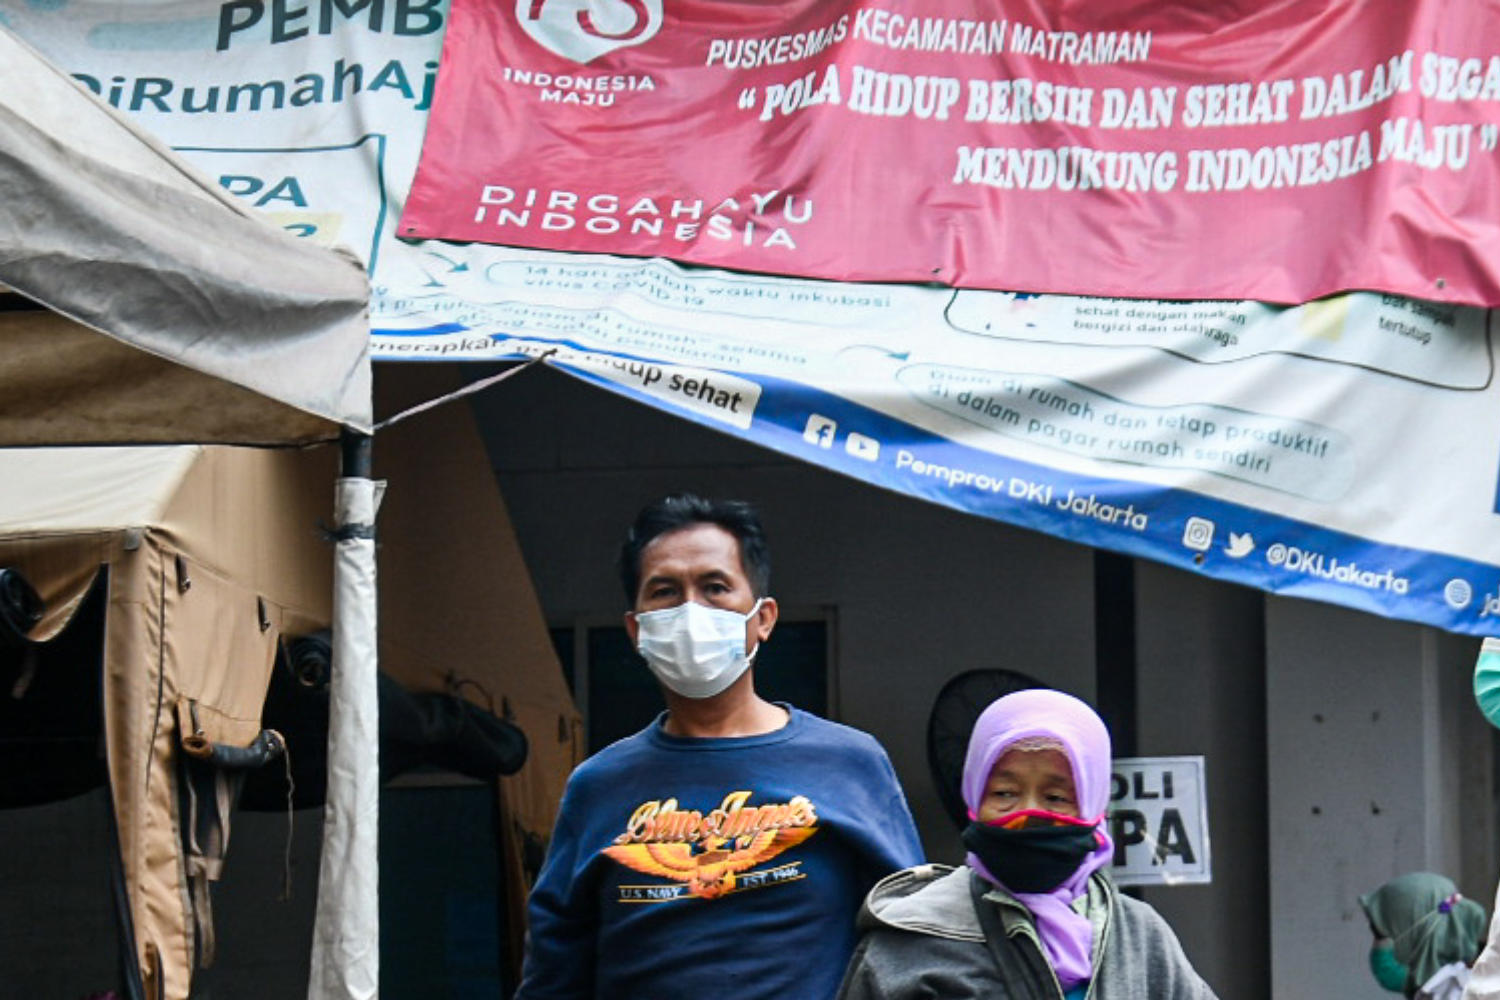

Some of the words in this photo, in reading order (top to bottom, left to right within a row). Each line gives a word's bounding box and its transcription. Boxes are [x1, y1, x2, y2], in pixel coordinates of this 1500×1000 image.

[705, 14, 849, 69] PUSKESMAS
[852, 8, 1007, 55] KECAMATAN
[1010, 22, 1152, 66] MATRAMAN
[503, 68, 655, 91] INDONESIA
[540, 89, 615, 107] MAJU
[847, 65, 961, 121] HIDUP
[965, 78, 1094, 127] BERSIH
[1100, 86, 1177, 129] DAN
[1182, 79, 1295, 128] SEHAT
[1300, 49, 1414, 119] DALAM
[952, 145, 1180, 193] MENDUKUNG
[1185, 127, 1373, 192] INDONESIA
[474, 206, 796, 249] INDONESIA
[481, 185, 813, 224] DIRGAHAYU
[669, 373, 742, 413] sehat
[957, 390, 1020, 426] dalam
[1028, 418, 1099, 449] pagar
[1107, 438, 1184, 459] rumah
[1194, 446, 1272, 474] sendiri
[1028, 387, 1095, 422] rumah
[1103, 410, 1147, 430] dan
[1157, 413, 1216, 440] tetap
[1226, 423, 1331, 459] produktif
[896, 449, 1004, 493] Pemprov
[1008, 477, 1053, 506] DKI
[1057, 490, 1149, 531] Jakarta
[1265, 541, 1410, 596] @DKIJakarta
